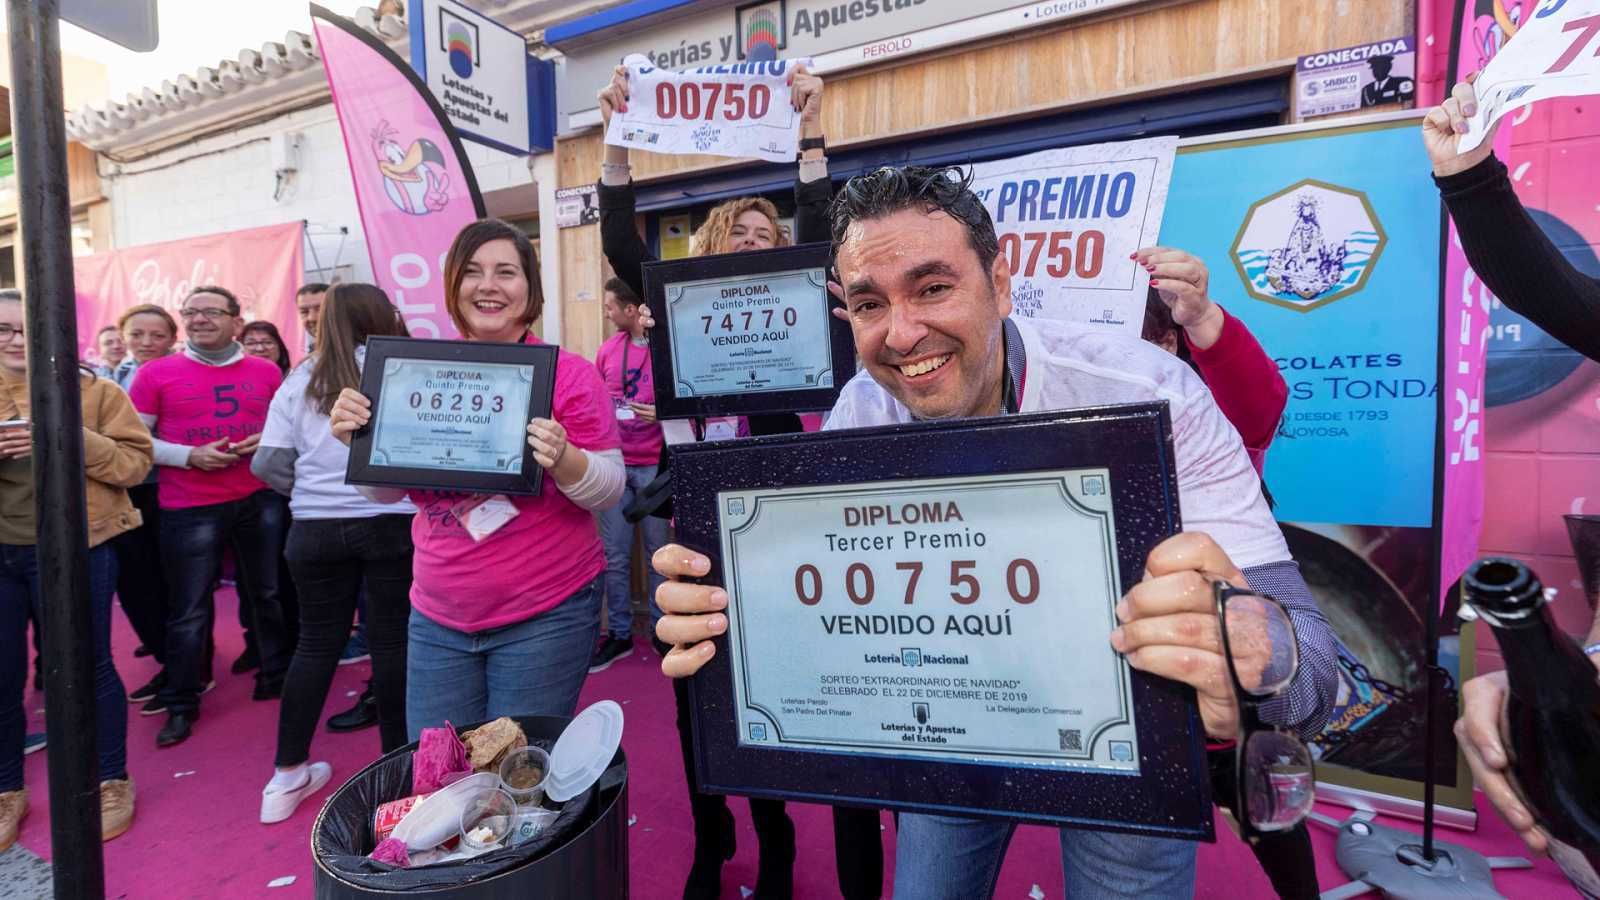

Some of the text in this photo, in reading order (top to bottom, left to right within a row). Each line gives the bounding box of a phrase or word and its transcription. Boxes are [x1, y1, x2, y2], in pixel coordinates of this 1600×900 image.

[719, 35, 732, 62] y
[863, 38, 912, 58] PEROLO
[1303, 40, 1407, 68] CONECTADA
[1542, 14, 1600, 74] 7
[443, 90, 509, 123] Apuestas del
[487, 95, 493, 106] y
[655, 82, 770, 120] 00750
[443, 103, 480, 126] Estado
[997, 172, 1136, 222] PREMIO
[721, 285, 770, 299] DIPLOMA
[712, 296, 780, 310] Quinto Premio
[701, 307, 797, 334] 74770
[711, 328, 789, 346] VENDIDO AQUÍ
[436, 370, 482, 380] DIPLOMA
[425, 380, 490, 391] Quinto Premio
[409, 391, 504, 413] 06293
[417, 412, 491, 425] VENDIDO AQUÍ
[1295, 411, 1342, 421] DESDE
[1350, 410, 1389, 421] 1793
[844, 501, 964, 526] DIPLOMA
[825, 527, 986, 551] Tercer Premio
[795, 558, 1040, 605] 00750
[821, 609, 1012, 636] VENDIDO AQUÍ
[923, 654, 968, 665] Nacional
[820, 675, 1021, 689] SORTEO "EXTRAORDINARIO DE NAVIDAD"
[821, 686, 1028, 701] CELEBRADO EL 22 DE DICIEMBRE DE 2019
[902, 733, 947, 743] del Estado
[918, 725, 923, 734] y
[926, 724, 966, 735] Apuestas
